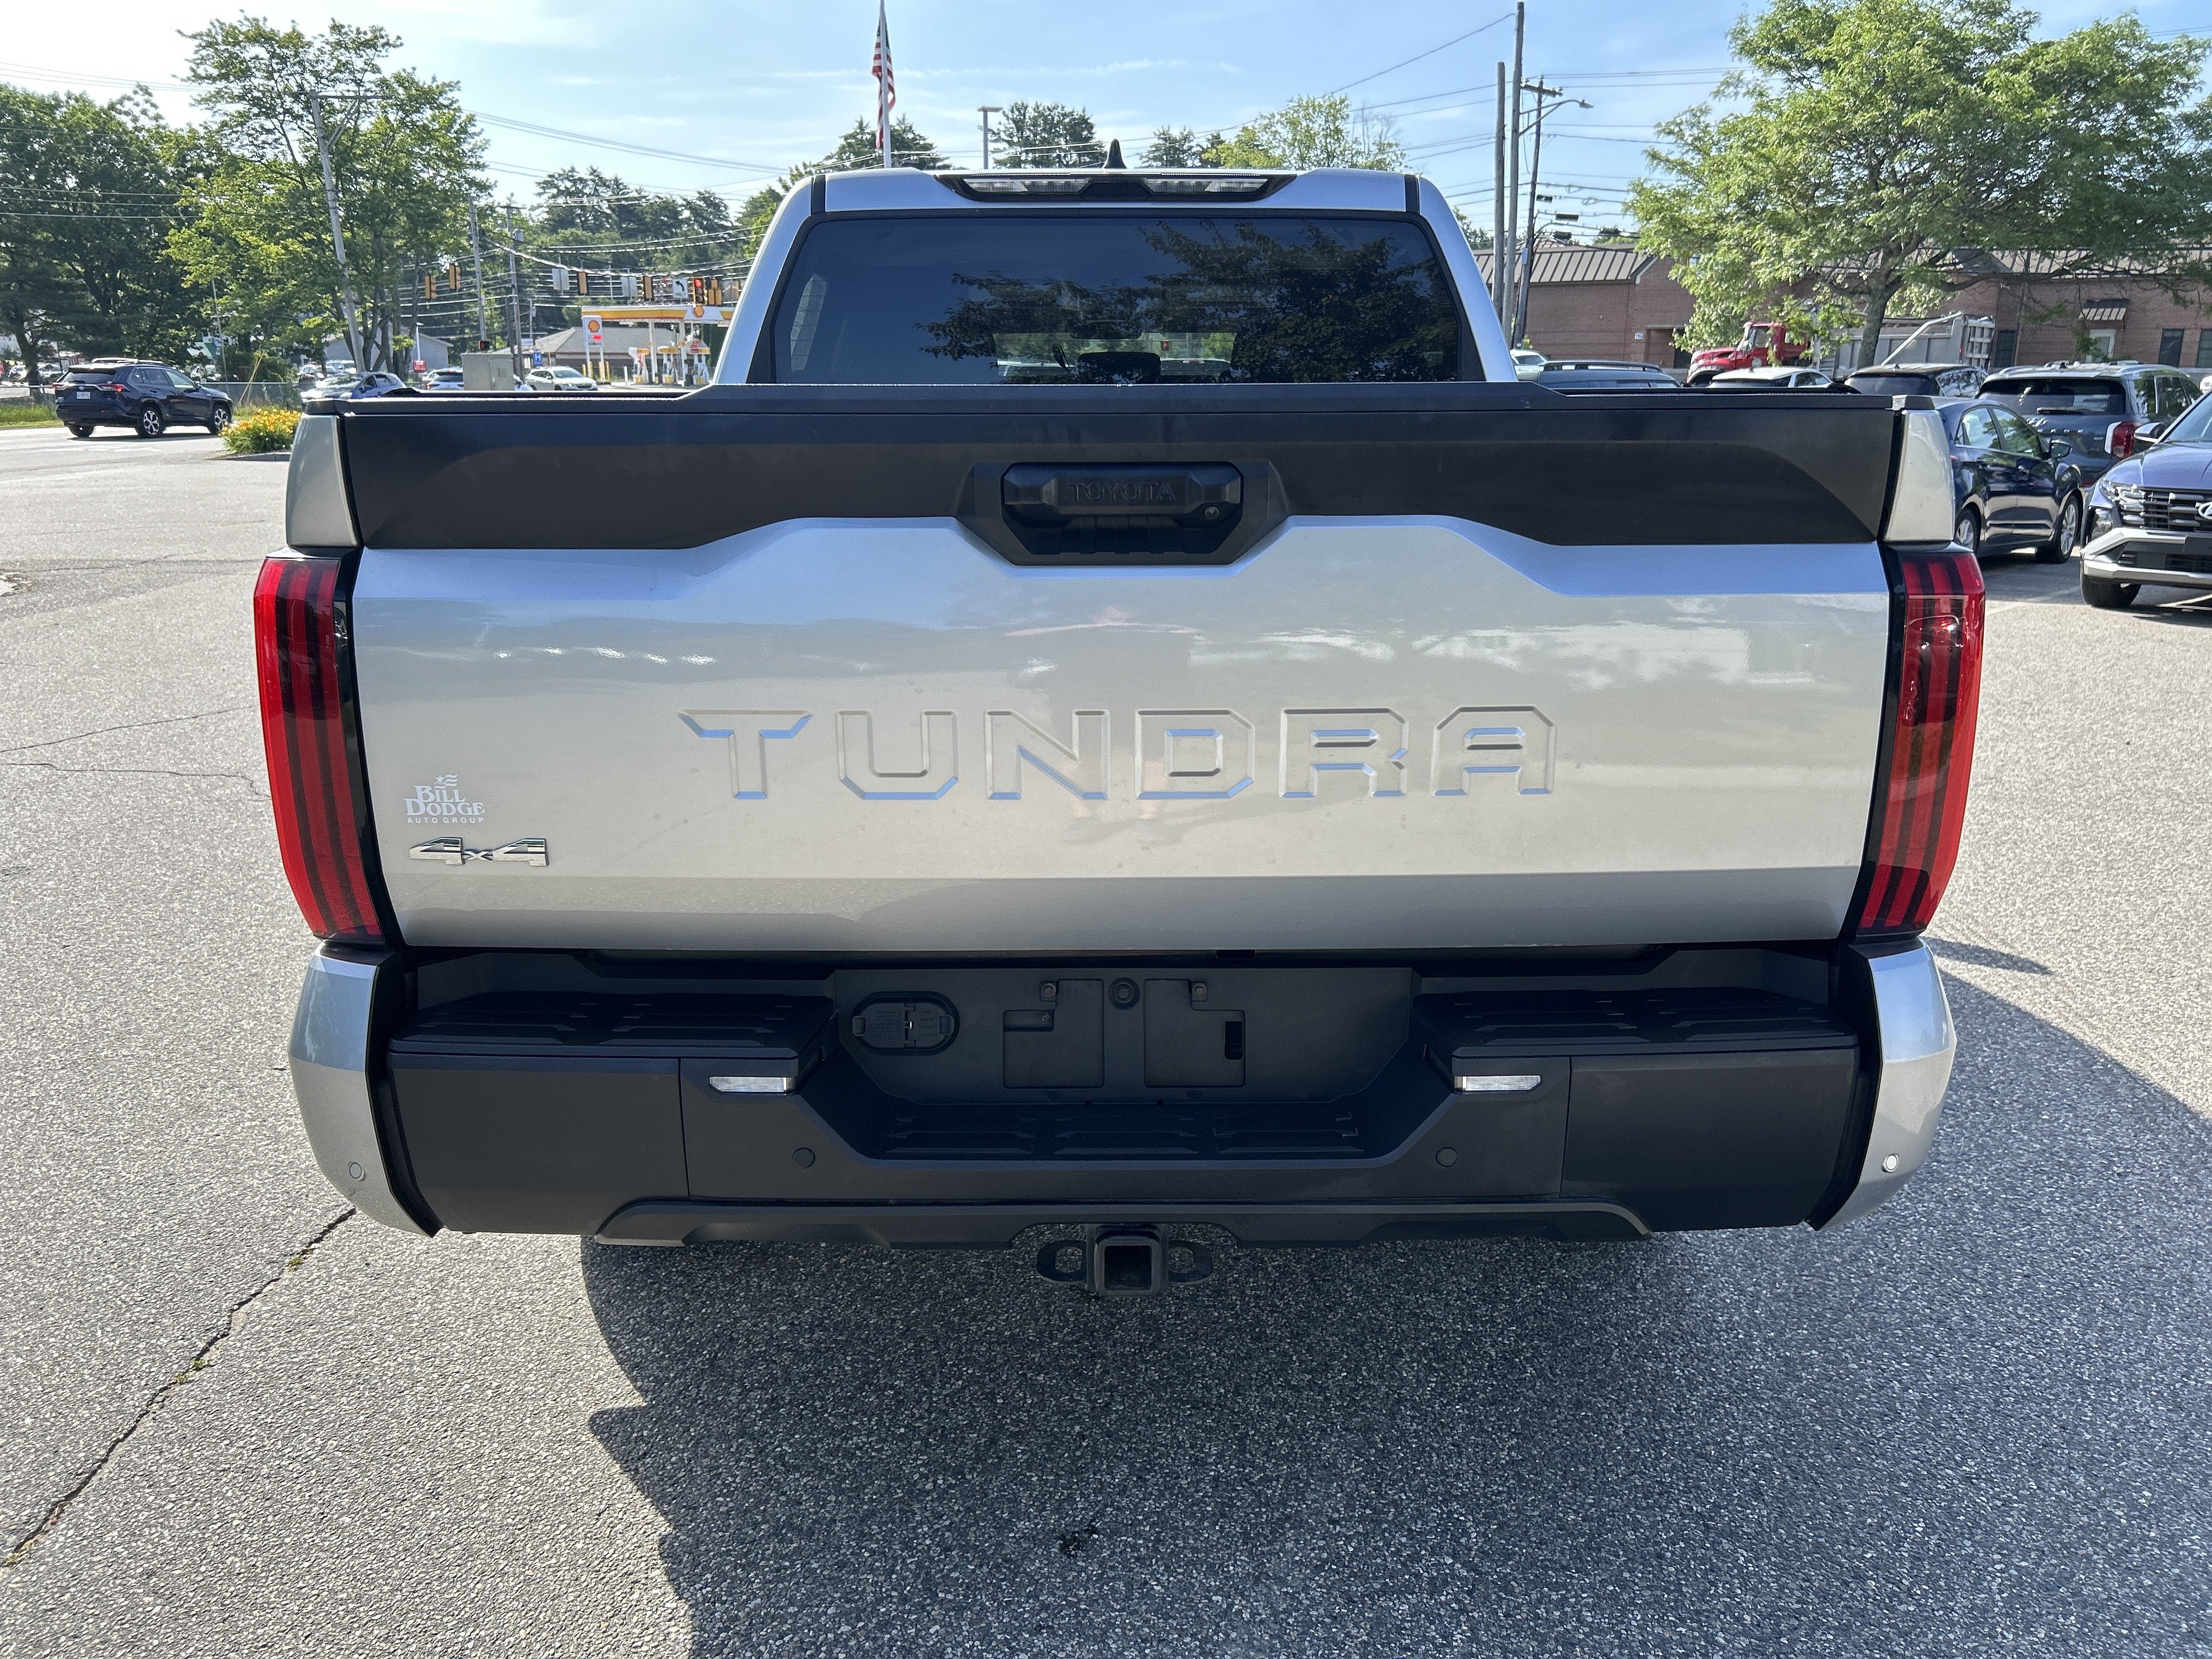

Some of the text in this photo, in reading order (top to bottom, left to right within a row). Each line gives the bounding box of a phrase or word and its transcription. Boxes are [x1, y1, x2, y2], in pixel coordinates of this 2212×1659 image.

[534, 353, 541, 362] H
[1066, 481, 1177, 503] TOYOTA
[676, 706, 1557, 800] TUNDRA
[414, 785, 466, 803] BILL
[404, 798, 486, 816] DODGE
[409, 837, 550, 867] 4x4
